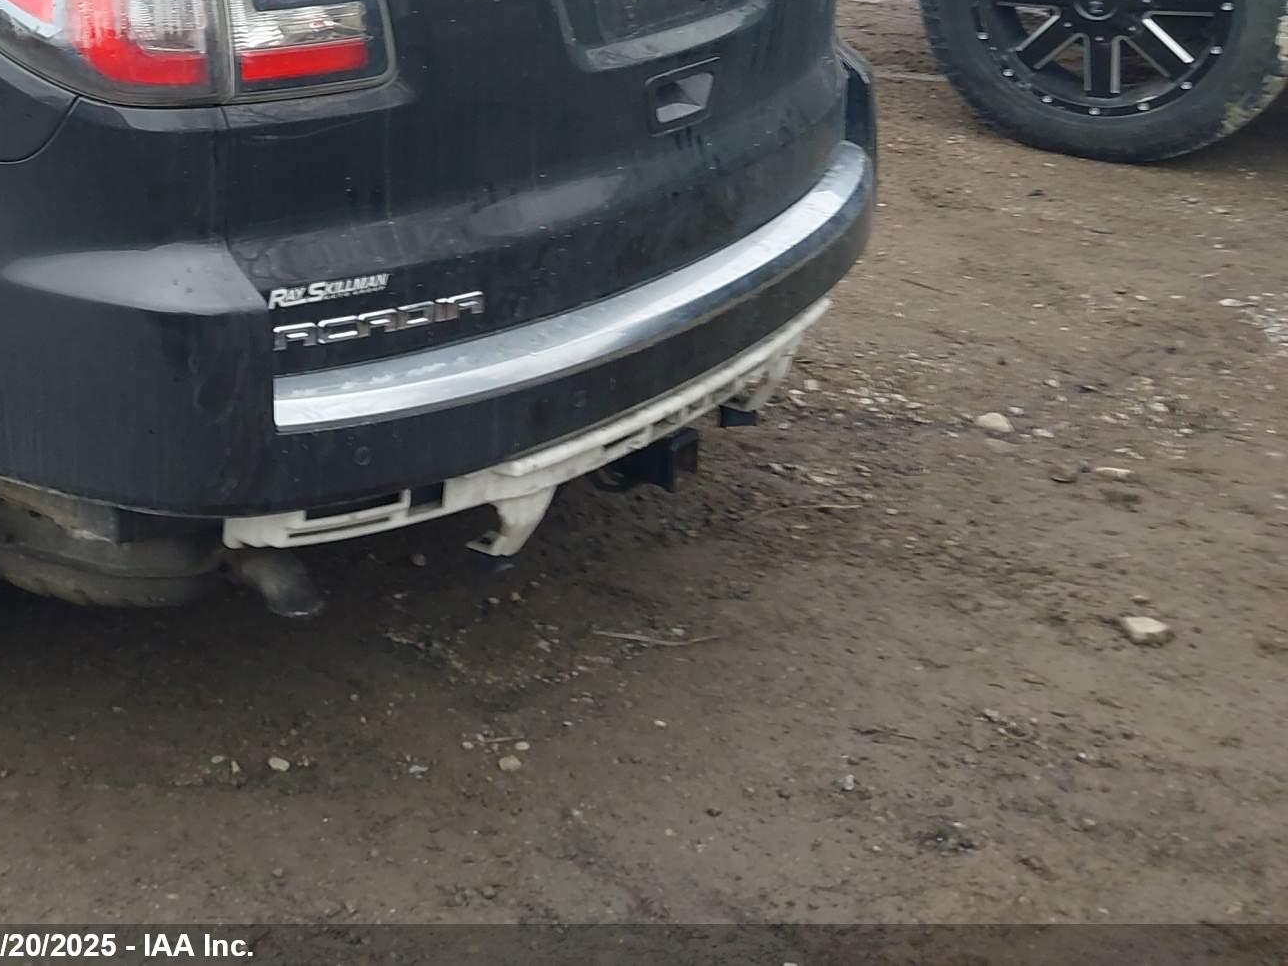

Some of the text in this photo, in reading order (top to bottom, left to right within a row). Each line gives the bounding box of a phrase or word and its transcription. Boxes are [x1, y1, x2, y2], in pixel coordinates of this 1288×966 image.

[268, 287, 307, 310] RAY
[307, 273, 392, 303] SKILLMAN
[272, 290, 485, 351] ACADIA
